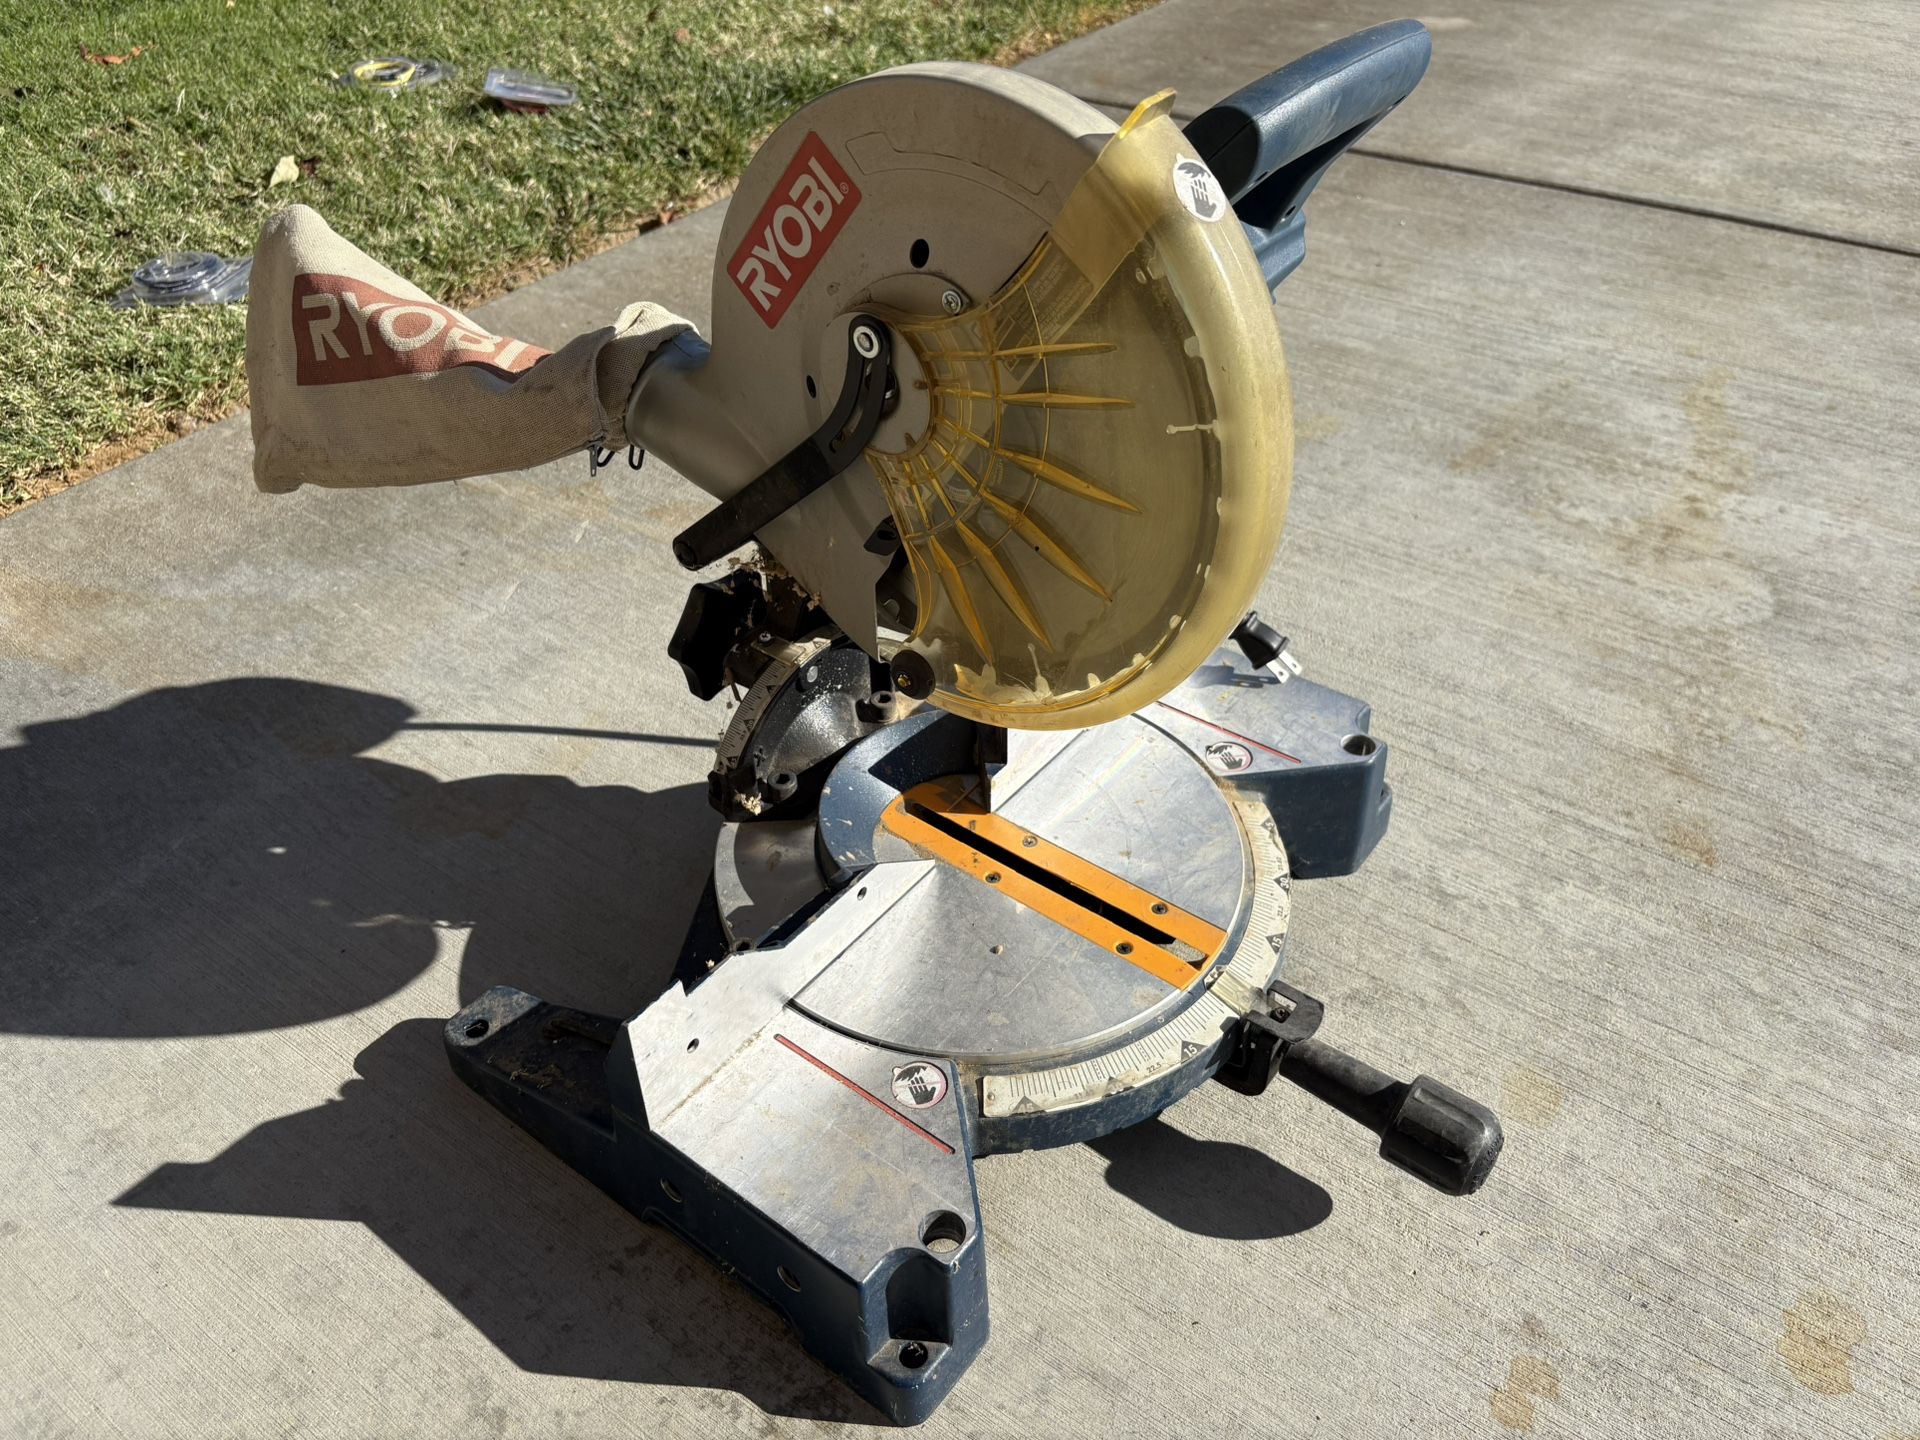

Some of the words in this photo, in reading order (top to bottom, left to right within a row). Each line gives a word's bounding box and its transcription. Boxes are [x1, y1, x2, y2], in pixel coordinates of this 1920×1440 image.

[736, 156, 845, 312] RYOBI
[301, 292, 528, 370] RYOBI
[1271, 936, 1283, 949] 15
[1183, 1043, 1198, 1059] 15
[1146, 1062, 1162, 1073] 22.5
